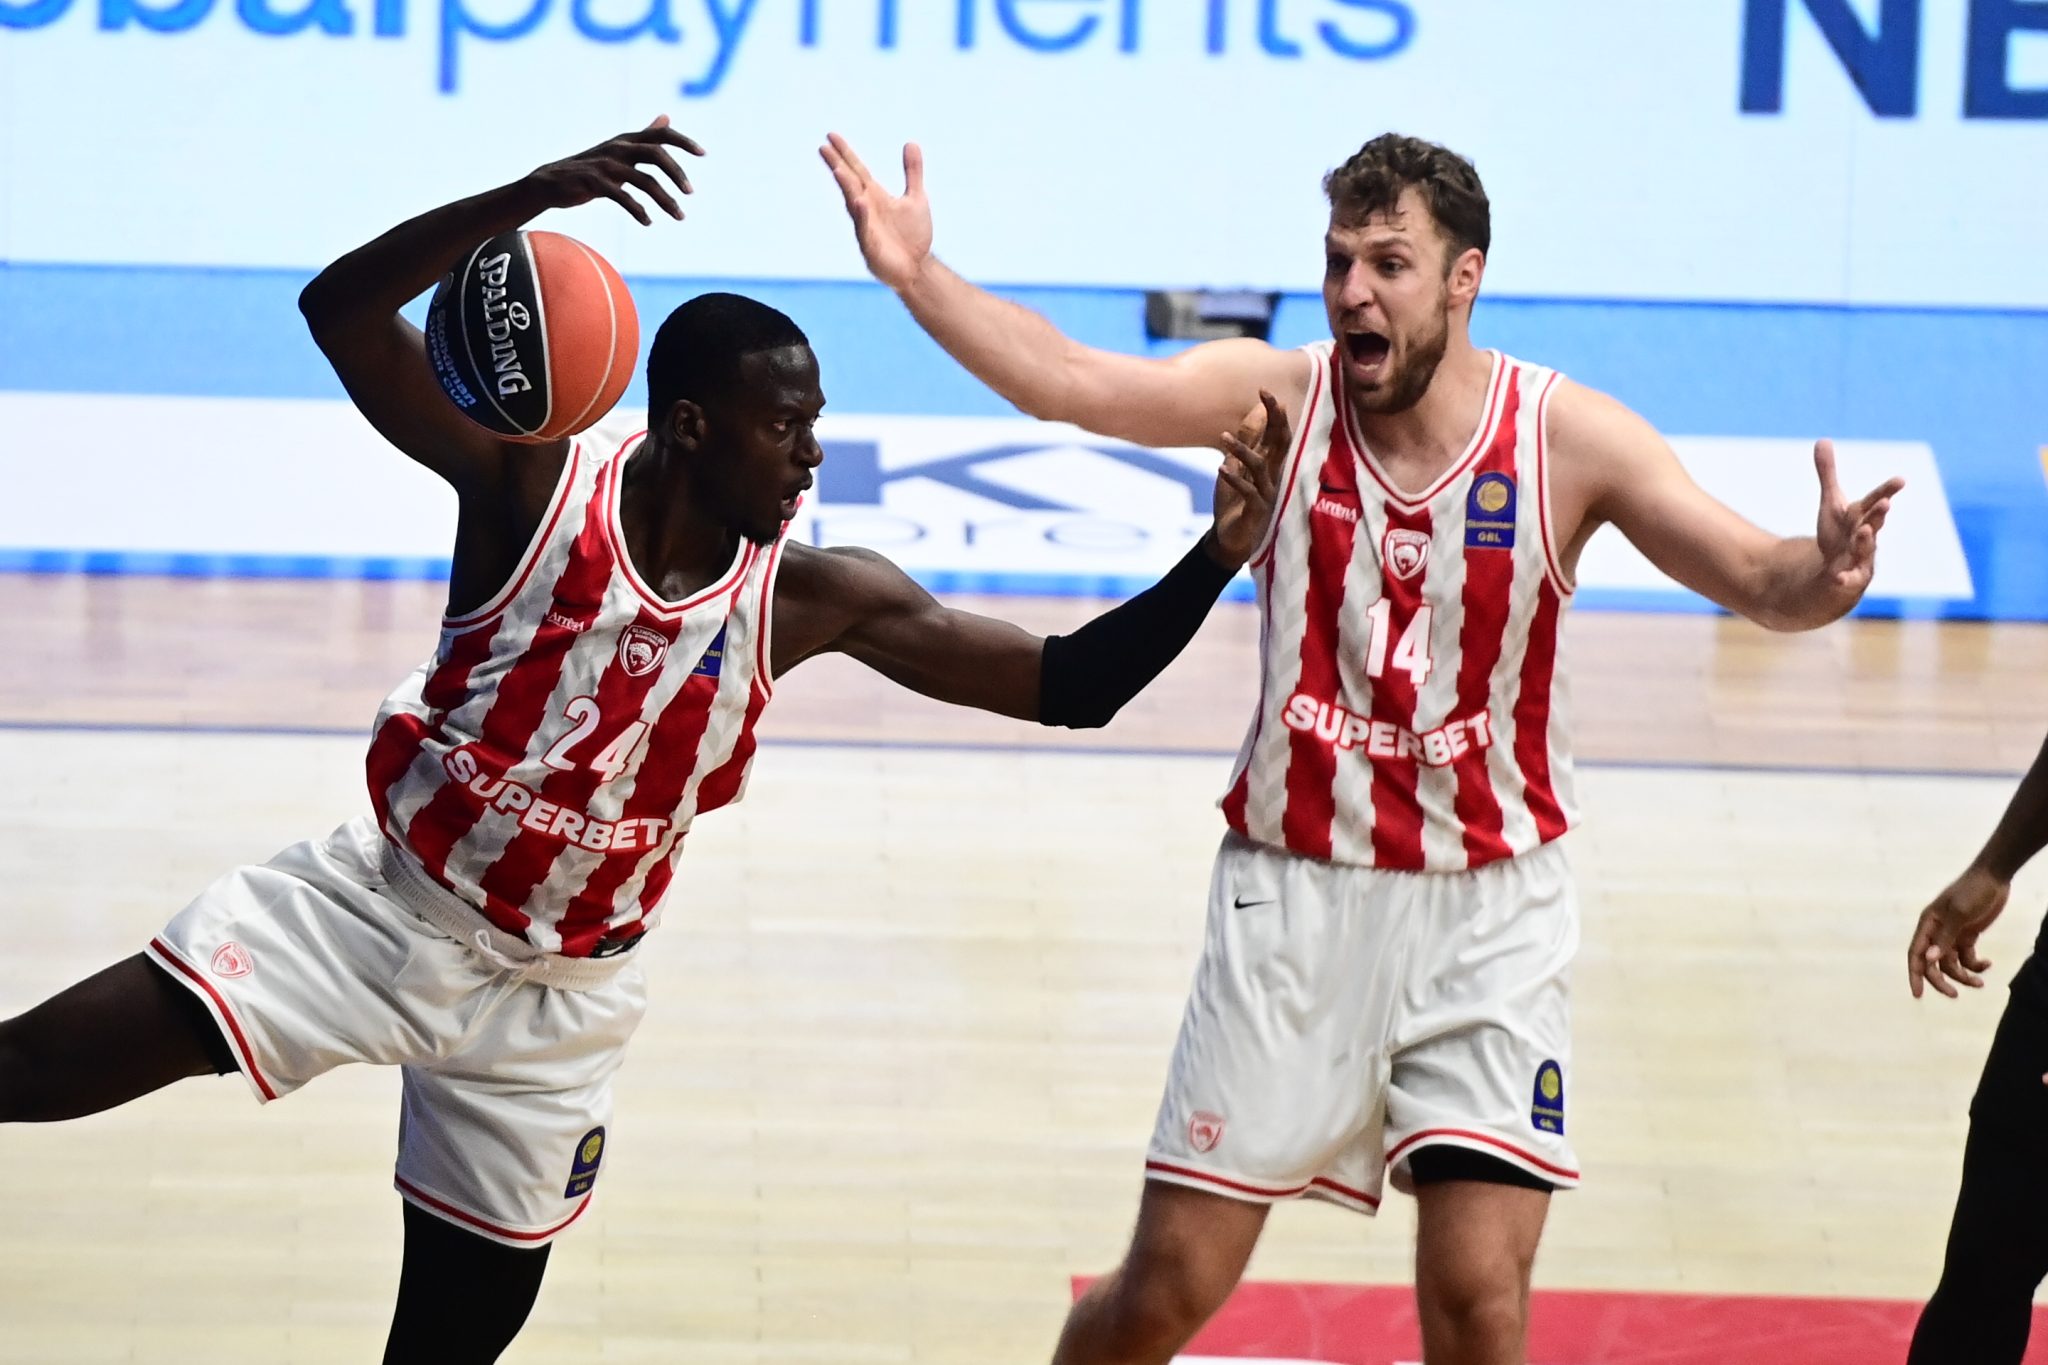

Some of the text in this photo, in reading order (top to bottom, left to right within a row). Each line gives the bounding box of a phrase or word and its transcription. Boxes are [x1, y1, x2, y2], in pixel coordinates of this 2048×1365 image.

[478, 252, 532, 397] SPALDING
[1366, 597, 1434, 686] 14
[541, 695, 649, 782] 24
[1284, 694, 1491, 766] SUPERBET
[446, 749, 671, 851] SUPERBET
